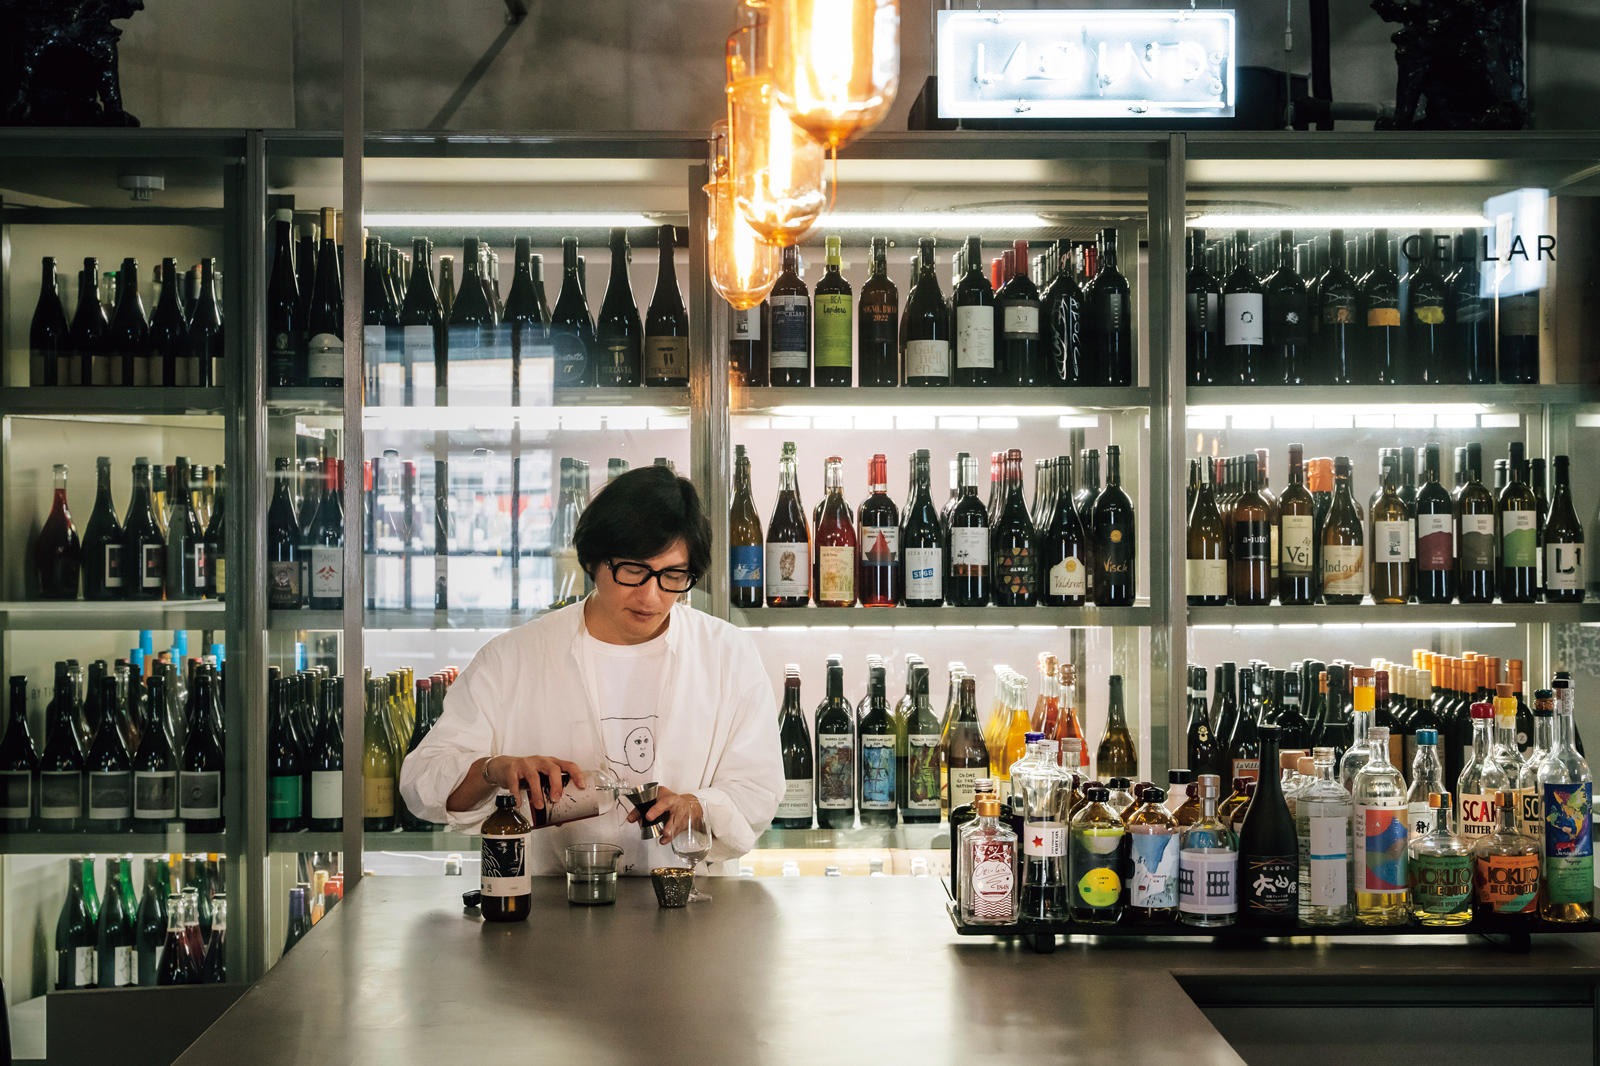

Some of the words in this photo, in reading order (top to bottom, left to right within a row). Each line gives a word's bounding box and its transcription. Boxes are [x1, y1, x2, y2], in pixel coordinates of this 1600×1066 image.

[1402, 235, 1556, 261] CELLAR
[1285, 546, 1309, 569] Vej
[913, 569, 934, 579] SP68
[1524, 797, 1542, 818] SC
[1464, 824, 1491, 834] BITTER
[1418, 867, 1471, 885] KOKUTO
[1488, 866, 1539, 885] KOKUTO
